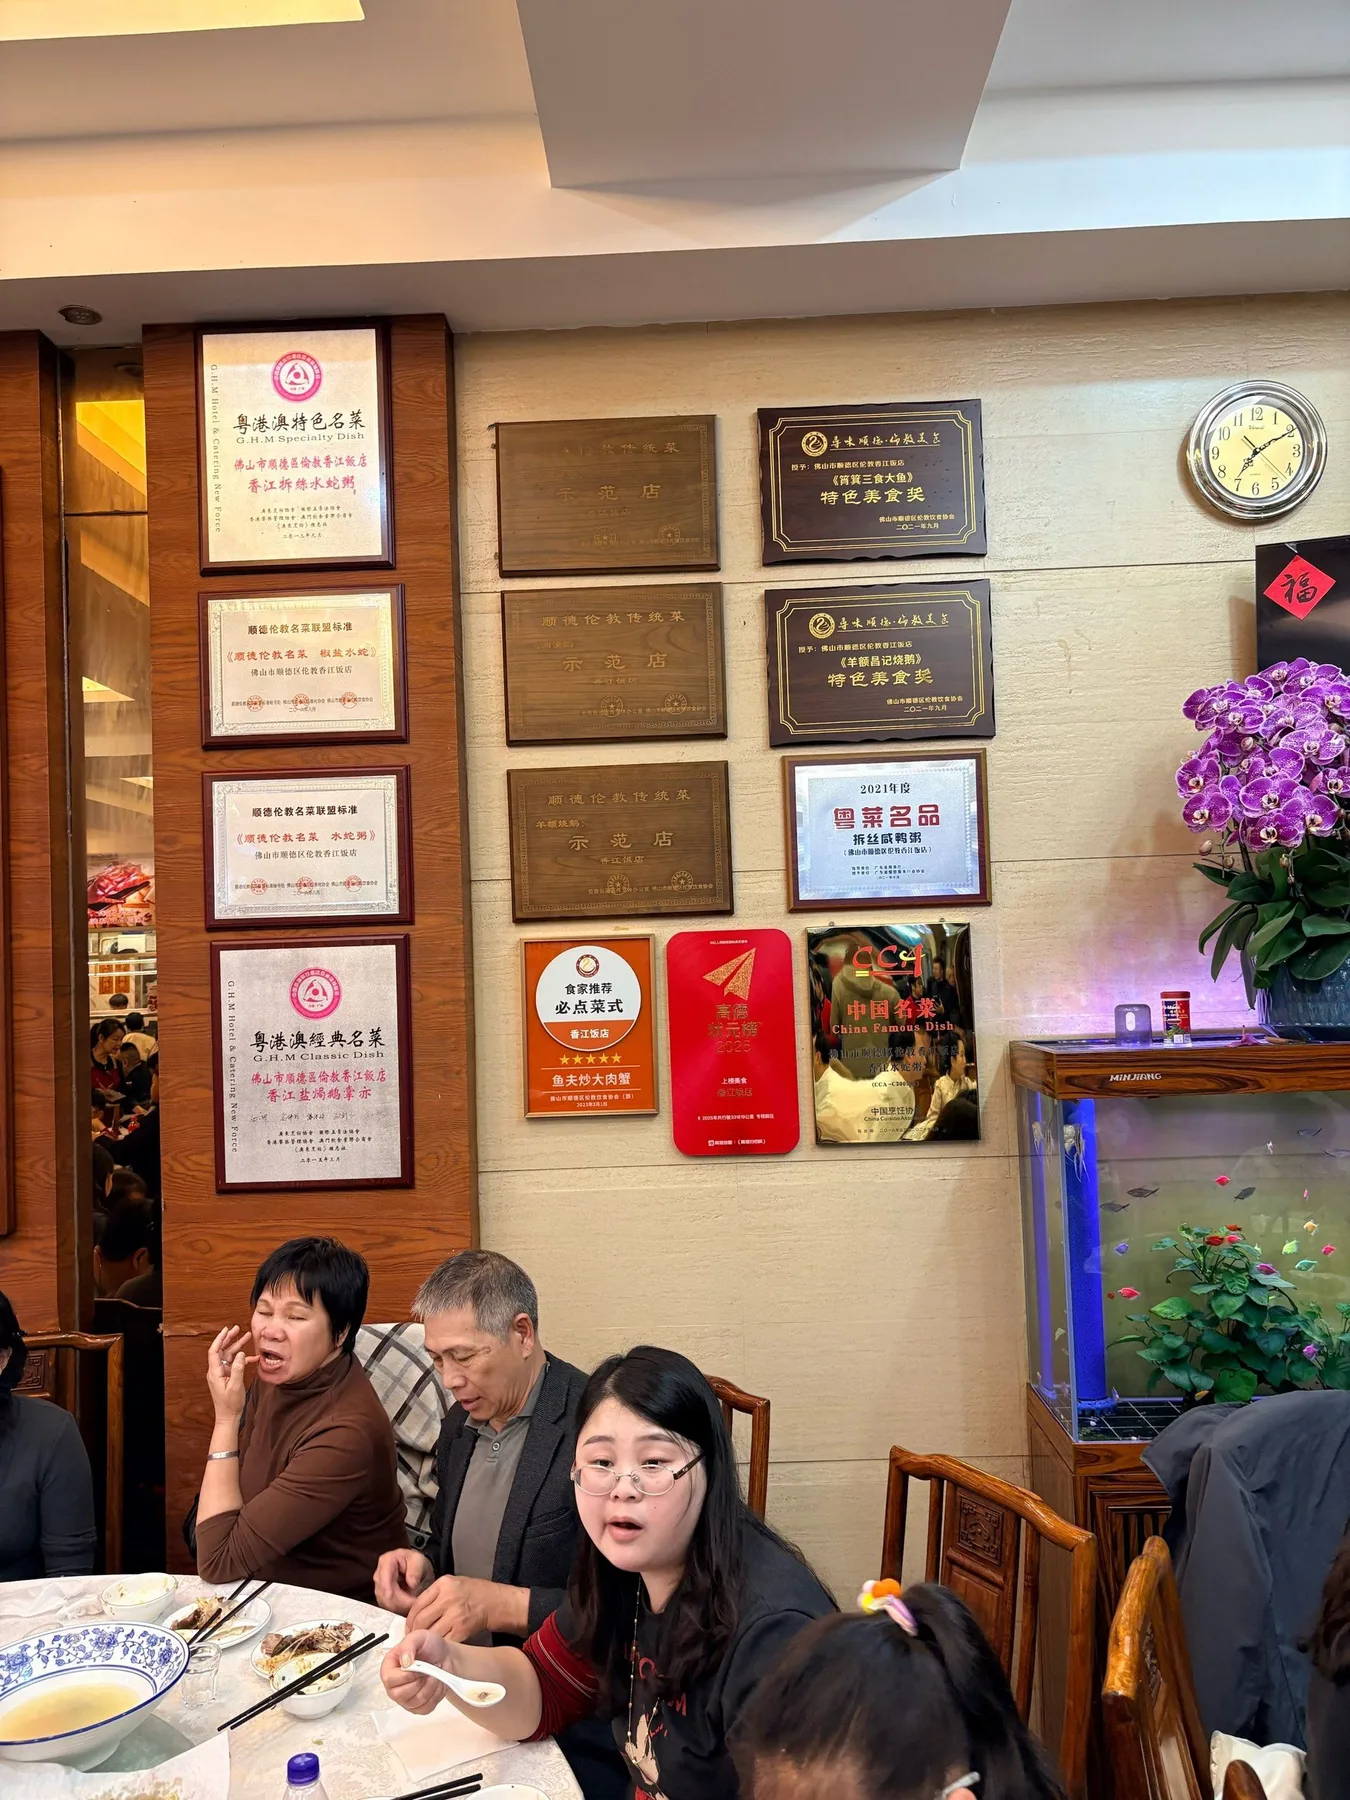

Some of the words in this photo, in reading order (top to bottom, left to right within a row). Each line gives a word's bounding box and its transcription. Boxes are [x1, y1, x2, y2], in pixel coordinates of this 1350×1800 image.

[1233, 412, 1243, 426] 11
[1250, 407, 1263, 421] 12
[1273, 412, 1278, 425] 1
[233, 409, 365, 434] 粤港澳特色名菜
[236, 436, 274, 444] G.H.M
[278, 434, 333, 444] Specialty
[337, 432, 364, 440] Dish
[1218, 426, 1230, 441] 10
[1286, 424, 1294, 438] 2
[1212, 446, 1220, 460] 9
[1292, 444, 1301, 457] 3
[212, 438, 221, 480] Catering
[814, 460, 904, 470] 佛山市顺德区伦教香江饭店
[1218, 464, 1227, 478] 8
[1285, 462, 1293, 476] 4
[1234, 478, 1242, 492] 7
[1252, 482, 1260, 496] 6
[1271, 477, 1279, 490] 5
[214, 484, 222, 502] New
[557, 484, 662, 502] 示范店
[820, 486, 926, 506] 特色美食奖
[878, 514, 955, 524] 佛山市顺德区伦教饮食协会
[1280, 572, 1318, 604] 福
[542, 611, 686, 627] 顺德伦教传统菜
[248, 622, 353, 636] 顺德伦教名菜联盟标准
[821, 641, 912, 652] 佛山市顺德区伦教香江饭店
[562, 652, 668, 672] 示范店
[250, 666, 352, 677] 佛山市顺德区伦教香江饭店
[828, 668, 933, 688] 特色美食奖
[886, 696, 964, 706] 佛山市顺德区伦教饮食协会
[860, 782, 911, 794] 2021年度
[548, 788, 691, 806] 顺德伦教传统菜
[252, 804, 358, 818] 顺德伦教名菜联盟标准
[833, 804, 940, 830] 粤菜名品
[568, 831, 674, 850] 示范店
[852, 832, 922, 846] 拆丝咸鸭粥
[254, 848, 358, 860] 佛山市顺德区伦教香江饭店
[600, 856, 644, 864] 香江饭店
[565, 982, 613, 994] 食家推荐
[555, 998, 624, 1014] 必点菜式
[716, 1004, 748, 1020] 高德
[848, 998, 936, 1021] 中国名菜
[228, 1016, 236, 1042] Hotel
[570, 1028, 610, 1040] 香江饭店
[832, 1024, 868, 1035] China
[873, 1022, 920, 1033] Famous
[926, 1020, 954, 1031] Dish
[250, 1026, 385, 1052] 粤港澳經典名菜
[716, 1040, 752, 1052] 2025
[254, 1054, 296, 1062] G.H.M
[300, 1052, 349, 1061] Classic
[353, 1050, 384, 1059] Dish
[868, 1062, 922, 1073] 香江水蛇粥
[229, 1057, 237, 1098] Catering
[552, 1072, 631, 1087] 鱼夫炒大肉蟹
[722, 1077, 747, 1085] 上榜美食
[230, 1102, 238, 1122] New
